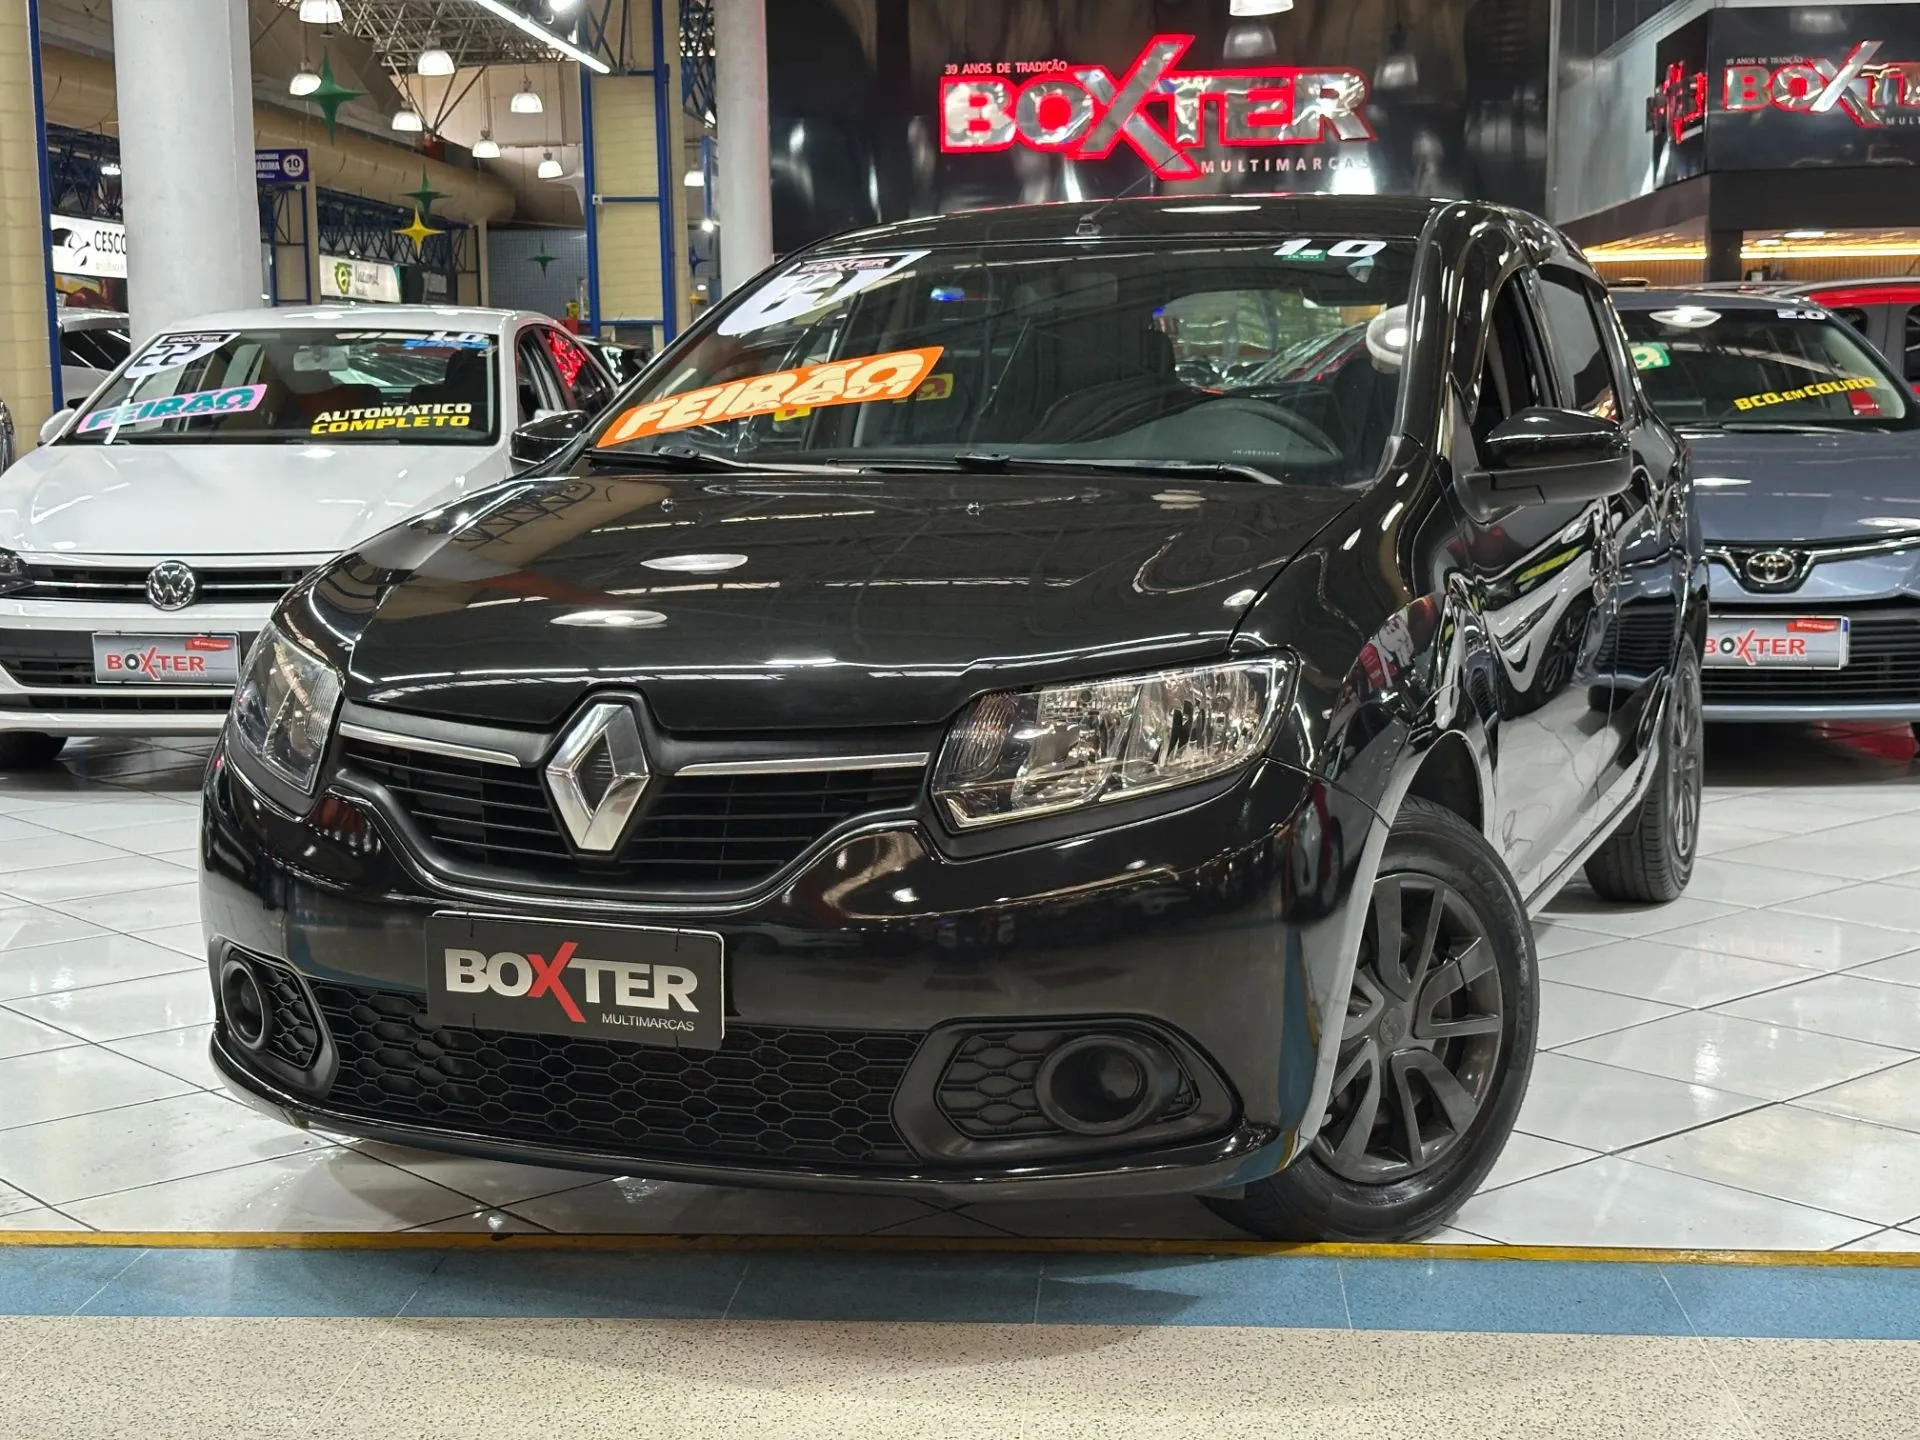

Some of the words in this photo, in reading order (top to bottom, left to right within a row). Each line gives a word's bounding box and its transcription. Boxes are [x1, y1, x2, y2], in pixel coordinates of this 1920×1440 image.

[945, 64, 957, 74] 39
[962, 63, 992, 74] ANOS
[996, 62, 1011, 73] DE
[1015, 58, 1067, 74] TRADIÇÃO
[941, 34, 1377, 180] BOXTER
[286, 158, 300, 168] 10
[1201, 158, 1368, 173] MULTIMARCAS
[1273, 238, 1387, 257] 1.0
[1776, 308, 1827, 320] 2.0
[614, 353, 925, 441] FEIRÃO
[1785, 388, 1806, 402] EM
[1804, 376, 1877, 397] COURO
[313, 403, 472, 424] AUTOMATICO
[310, 415, 470, 435] COMPLETO
[1704, 628, 1808, 666] BOXTER
[105, 646, 206, 681] BOXTER
[444, 941, 700, 1024] BOXTER
[602, 1012, 695, 1032] MULTIMARCAS
